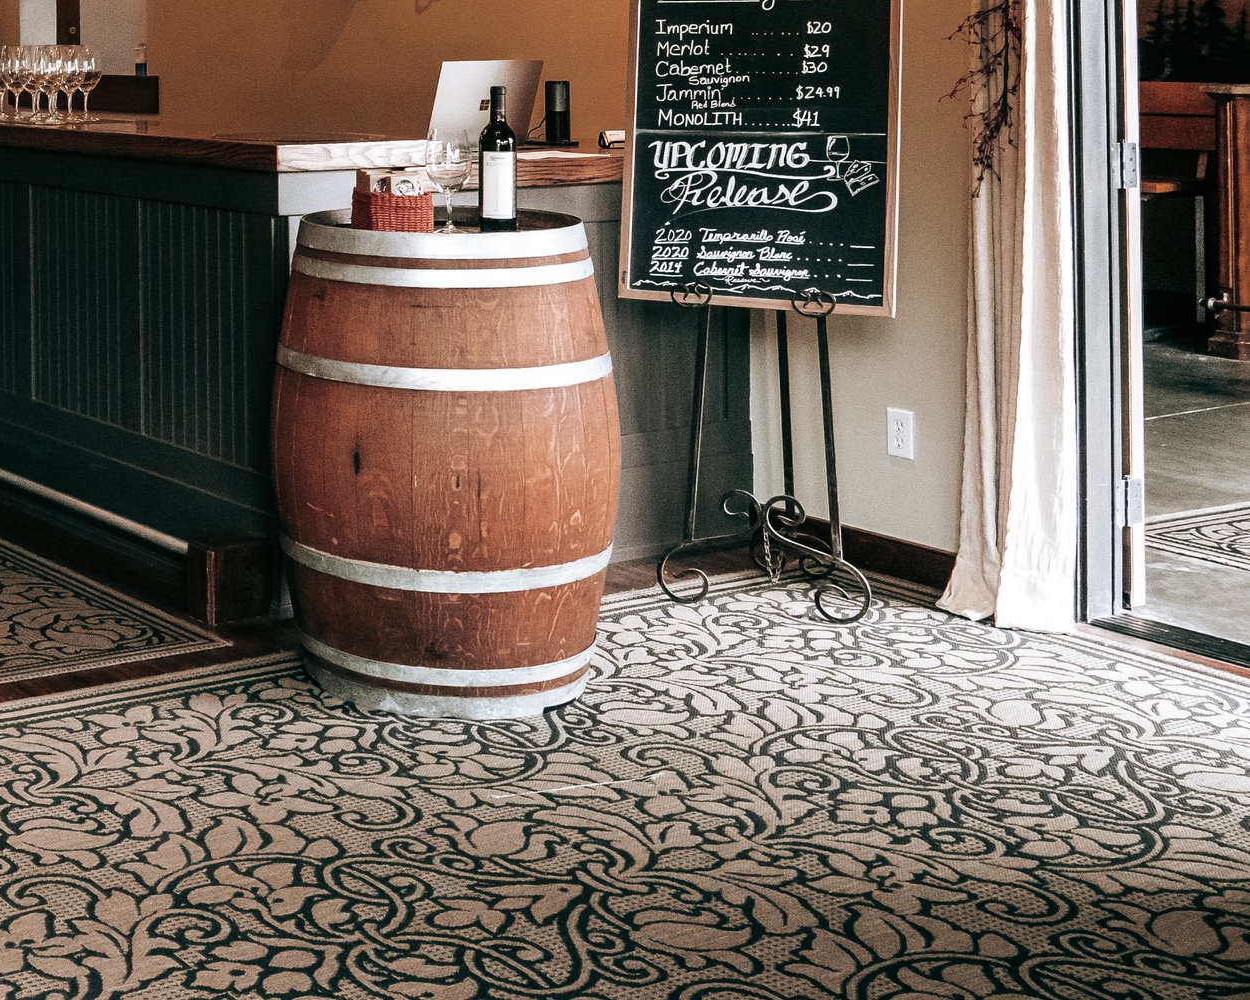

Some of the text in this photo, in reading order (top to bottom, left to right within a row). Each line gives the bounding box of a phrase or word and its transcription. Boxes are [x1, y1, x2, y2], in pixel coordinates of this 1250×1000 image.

[655, 19, 832, 41] Imperium $20
[656, 39, 830, 58] Merlot $29
[655, 57, 828, 77] Cabernet $30
[688, 74, 750, 88] Sauvignon
[795, 85, 841, 100] $24.99
[691, 97, 737, 110] Red Blend
[792, 107, 821, 128] $41
[648, 141, 811, 170] UPCOMING
[660, 171, 837, 214] Release
[654, 227, 806, 245] 2020 Tempranillo Rosé
[651, 245, 793, 262] 2020 Sauvignon Blanc
[693, 261, 749, 276] Cabernet
[749, 263, 810, 281] Sauvignon
